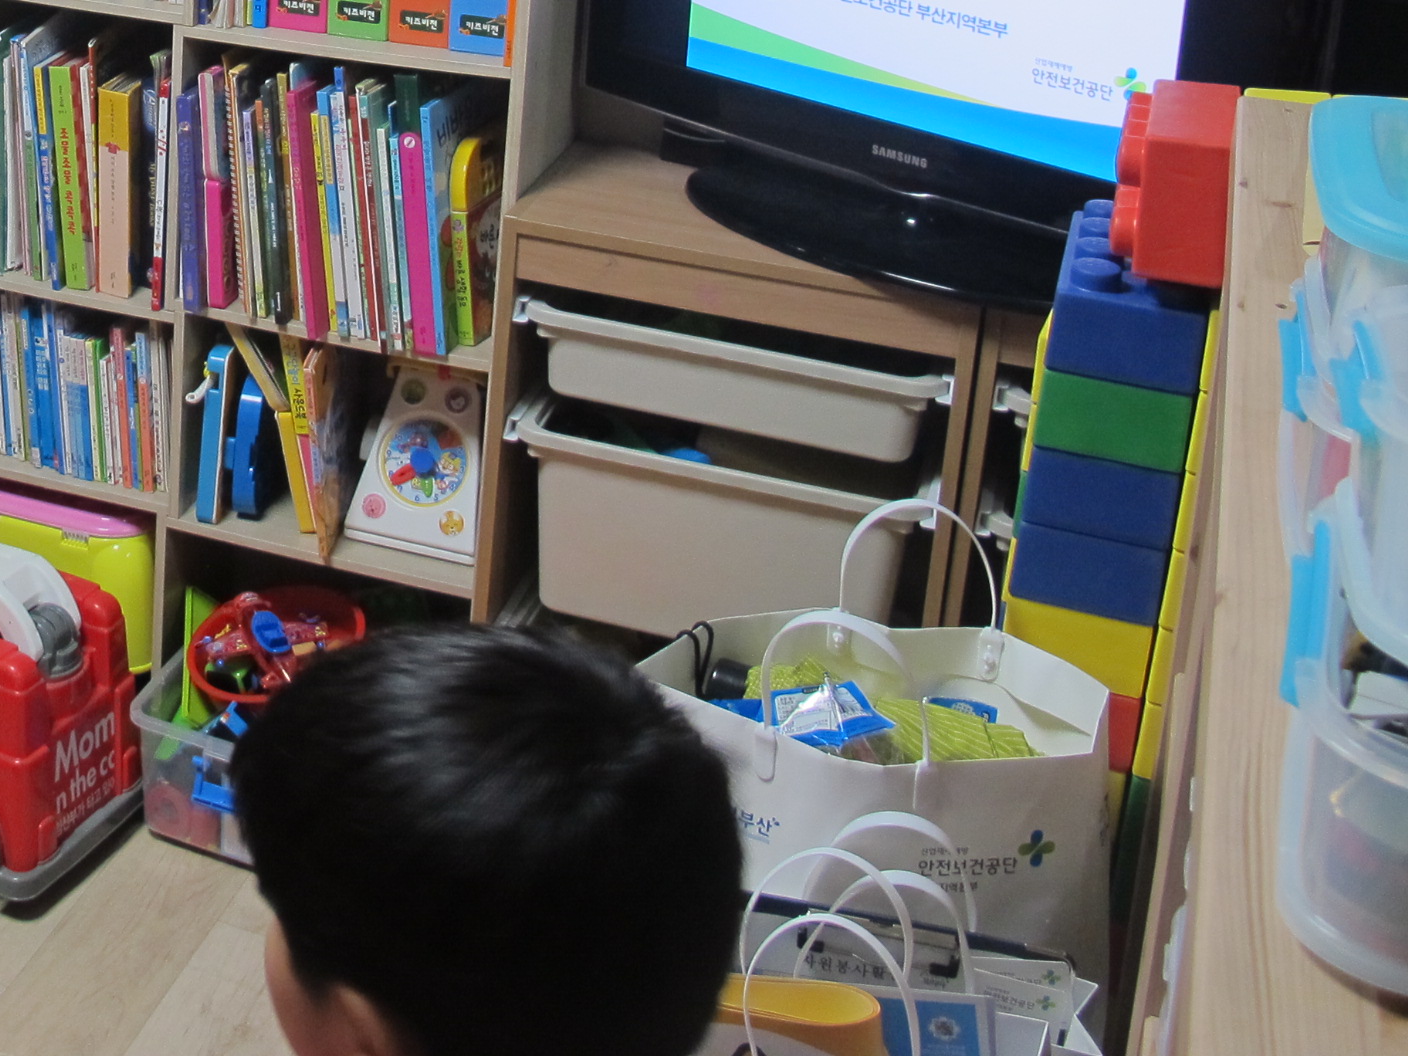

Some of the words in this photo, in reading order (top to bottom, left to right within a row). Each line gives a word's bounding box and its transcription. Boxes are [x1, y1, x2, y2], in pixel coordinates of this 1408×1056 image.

[283, 0, 315, 14] 키즈비전
[343, 6, 375, 21] 키즈비전
[405, 15, 438, 30] 키즈비전
[466, 20, 499, 35] 키즈비전
[915, 2, 1010, 40] 부산지역본부
[1031, 67, 1113, 102] 안전보건공단
[871, 143, 928, 169] SAMSUNG
[55, 711, 115, 783] Mom
[70, 766, 97, 802] the
